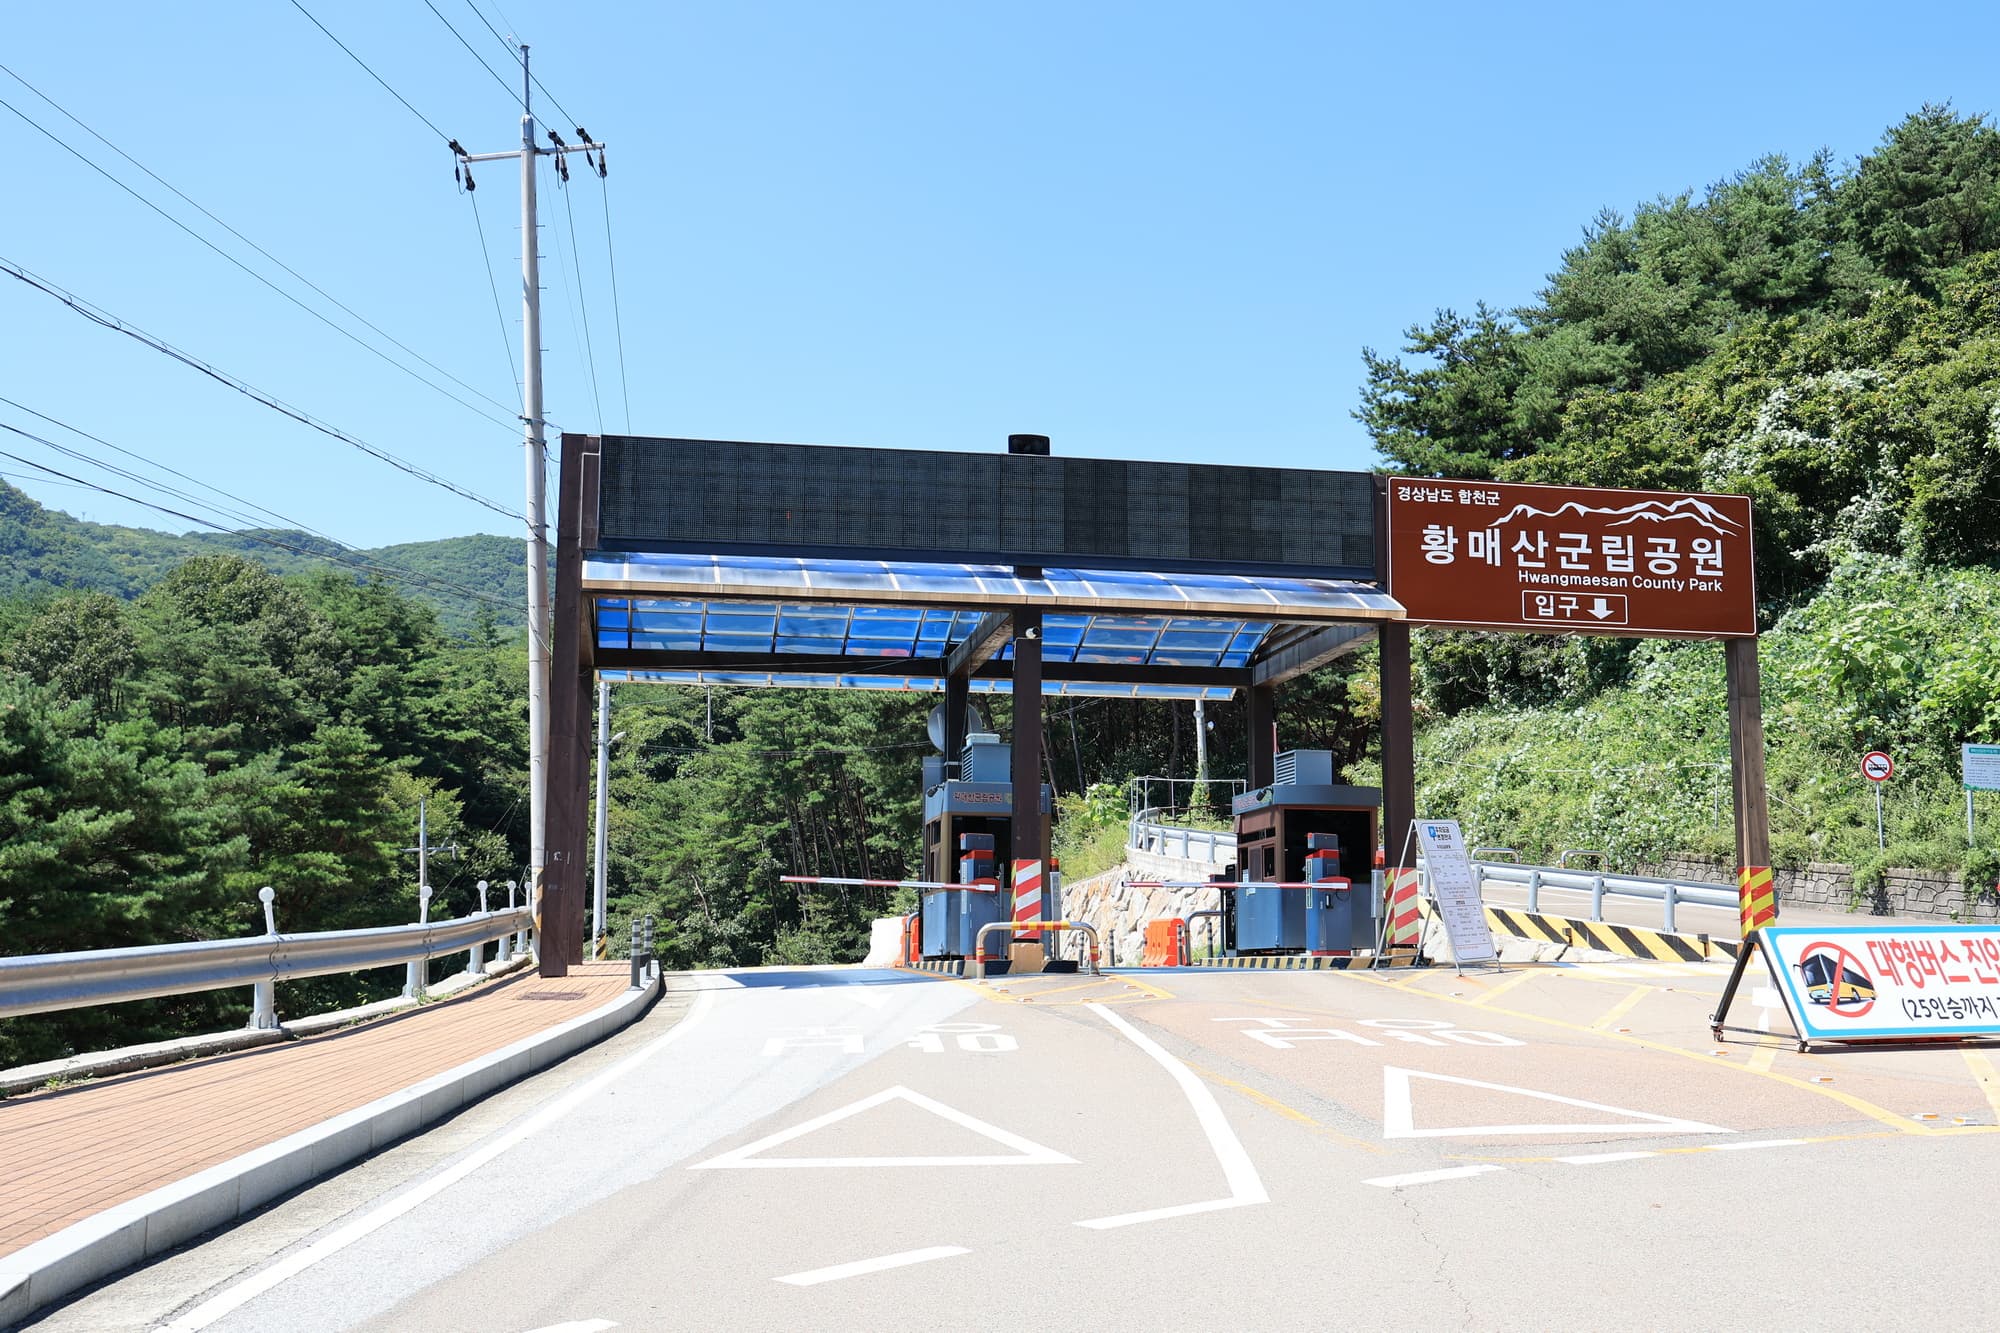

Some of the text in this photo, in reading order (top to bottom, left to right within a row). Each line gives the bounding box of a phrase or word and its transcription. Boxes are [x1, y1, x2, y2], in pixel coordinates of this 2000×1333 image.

[1397, 486, 1501, 506] 경상남도 합천군
[1421, 525, 1724, 576] 황매산군립공원
[1518, 570, 1723, 592] Hwangmaesan County Park
[1535, 595, 1580, 618] 입구
[1866, 938, 1971, 989] 대형버스
[1901, 996, 1998, 1021] (25인승까지
